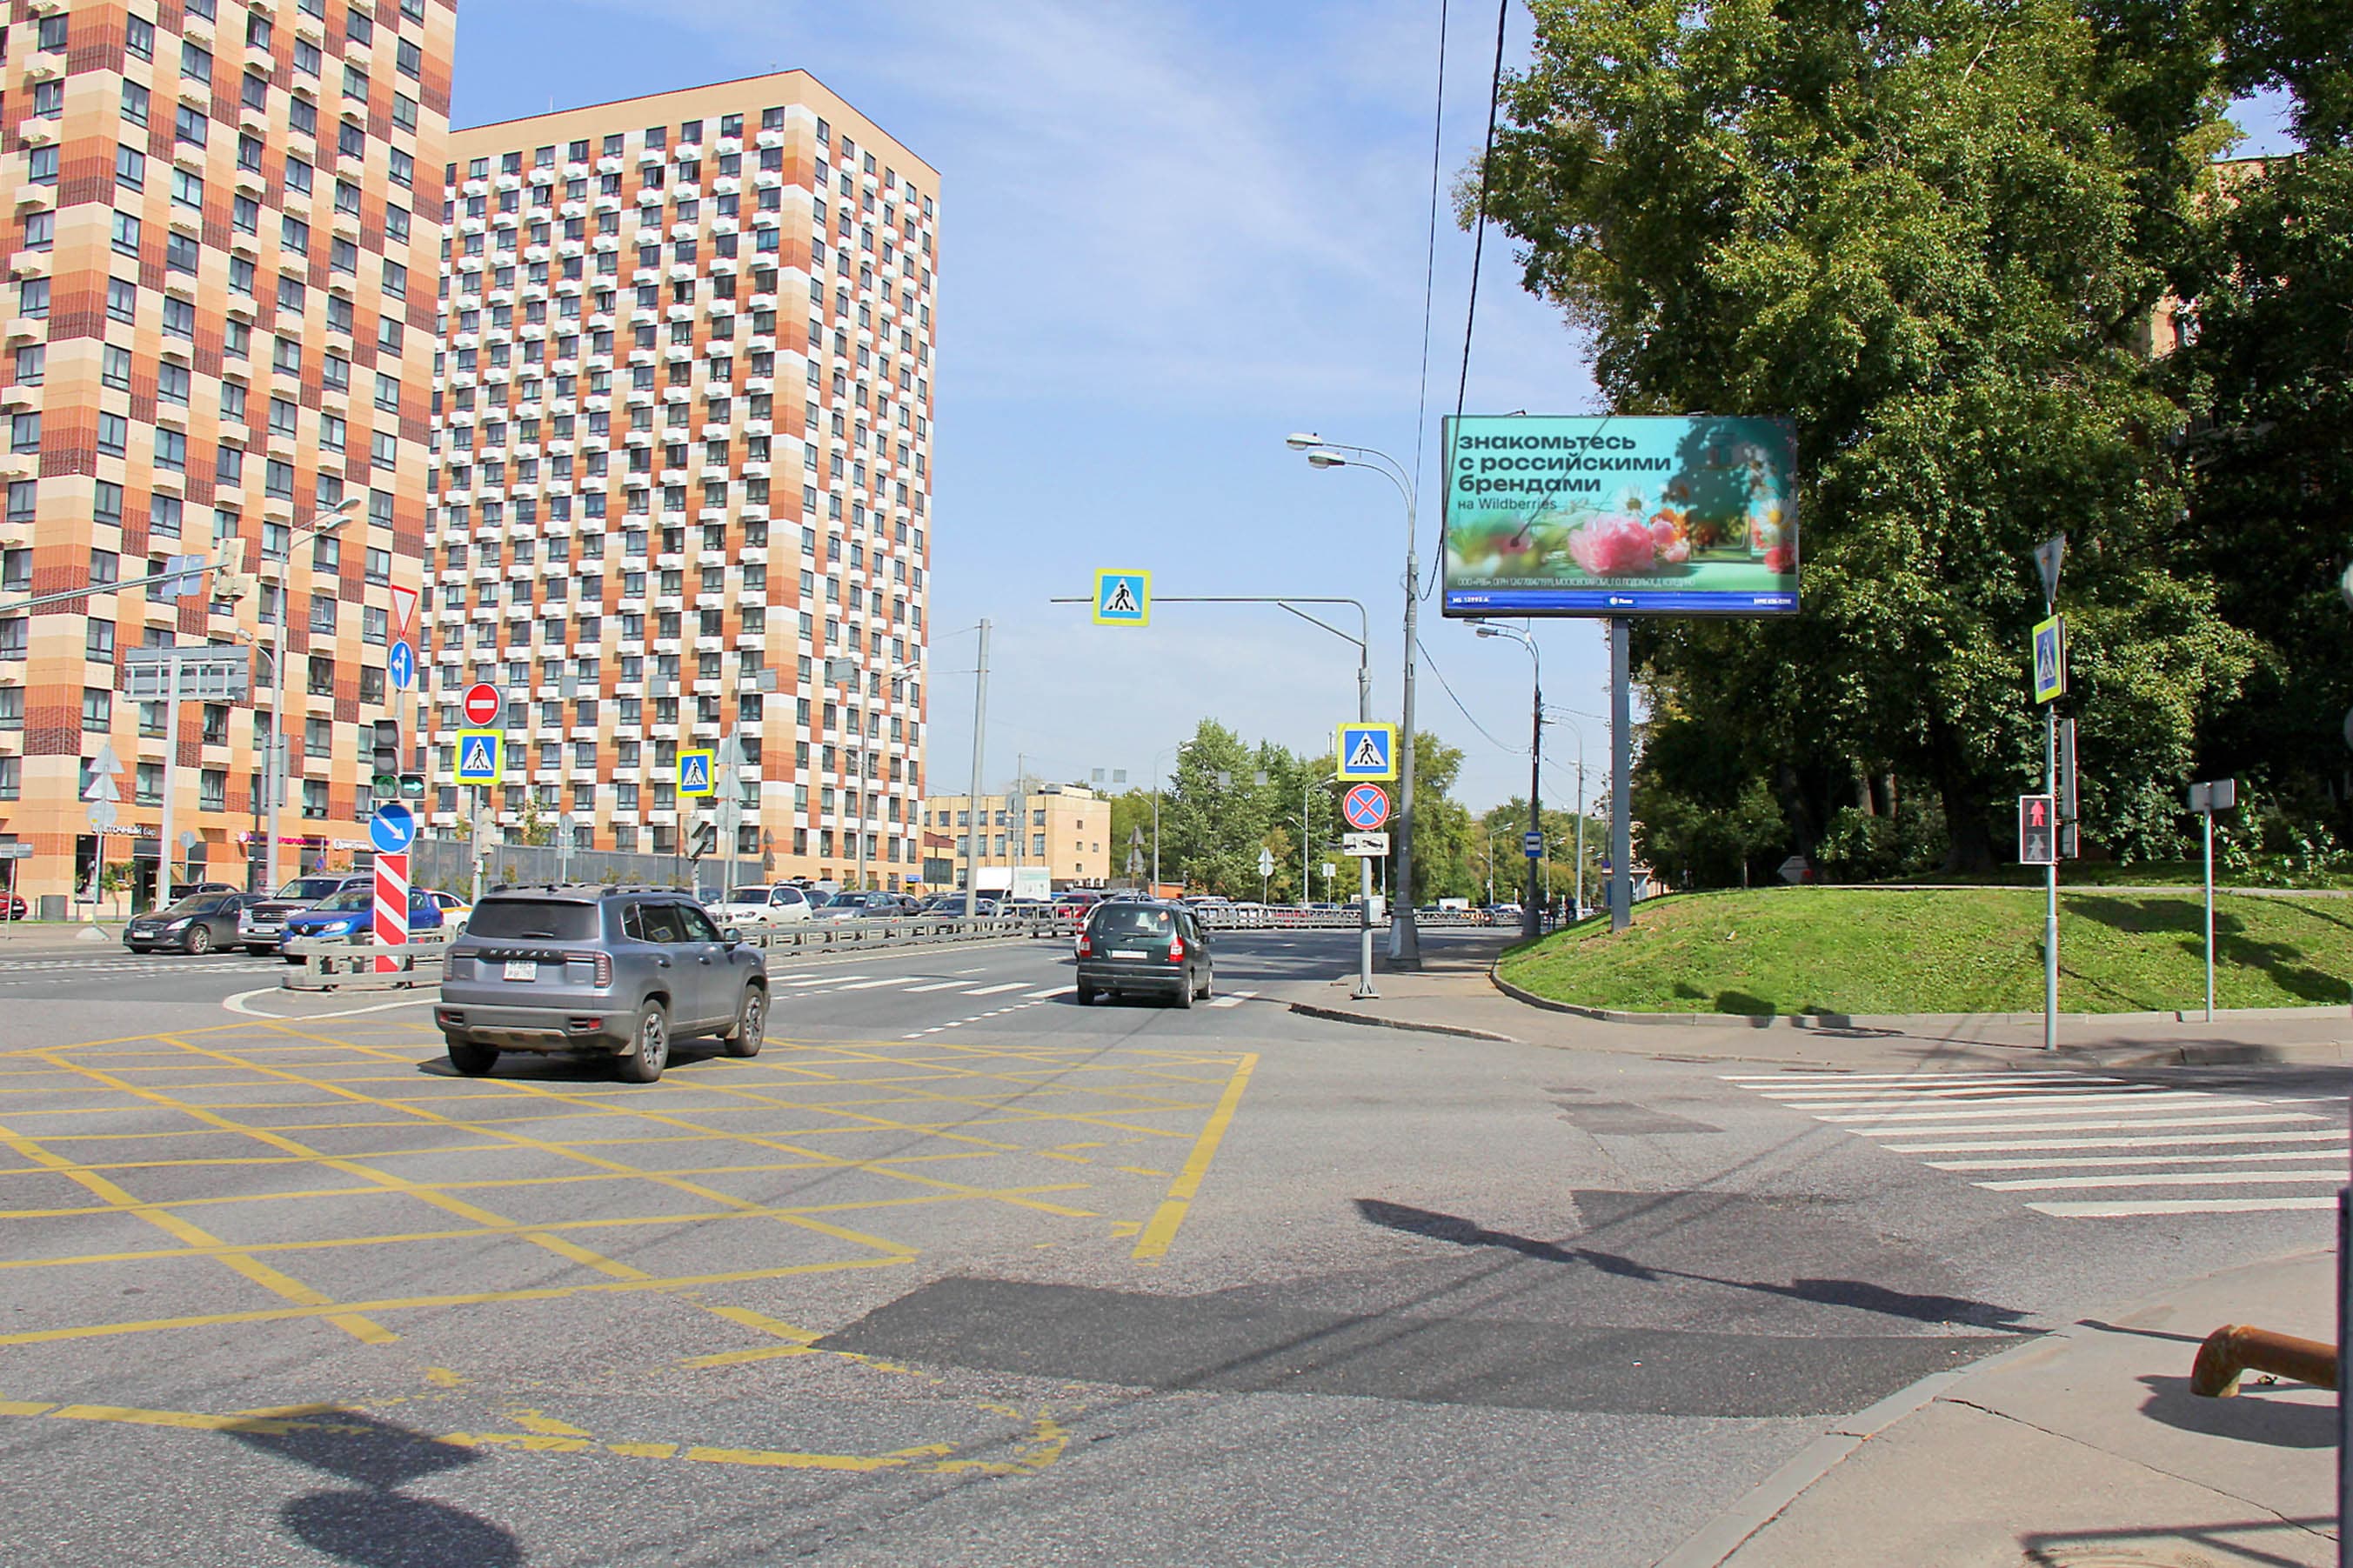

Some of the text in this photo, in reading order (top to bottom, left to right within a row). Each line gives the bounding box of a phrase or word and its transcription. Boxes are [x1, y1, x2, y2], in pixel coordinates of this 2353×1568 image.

[1459, 435, 1636, 450] знакомьтесь
[1458, 452, 1671, 474] с российскими
[1459, 474, 1601, 495] брендами
[1458, 497, 1557, 510] на Wildberries
[489, 949, 551, 957] HAVAL
